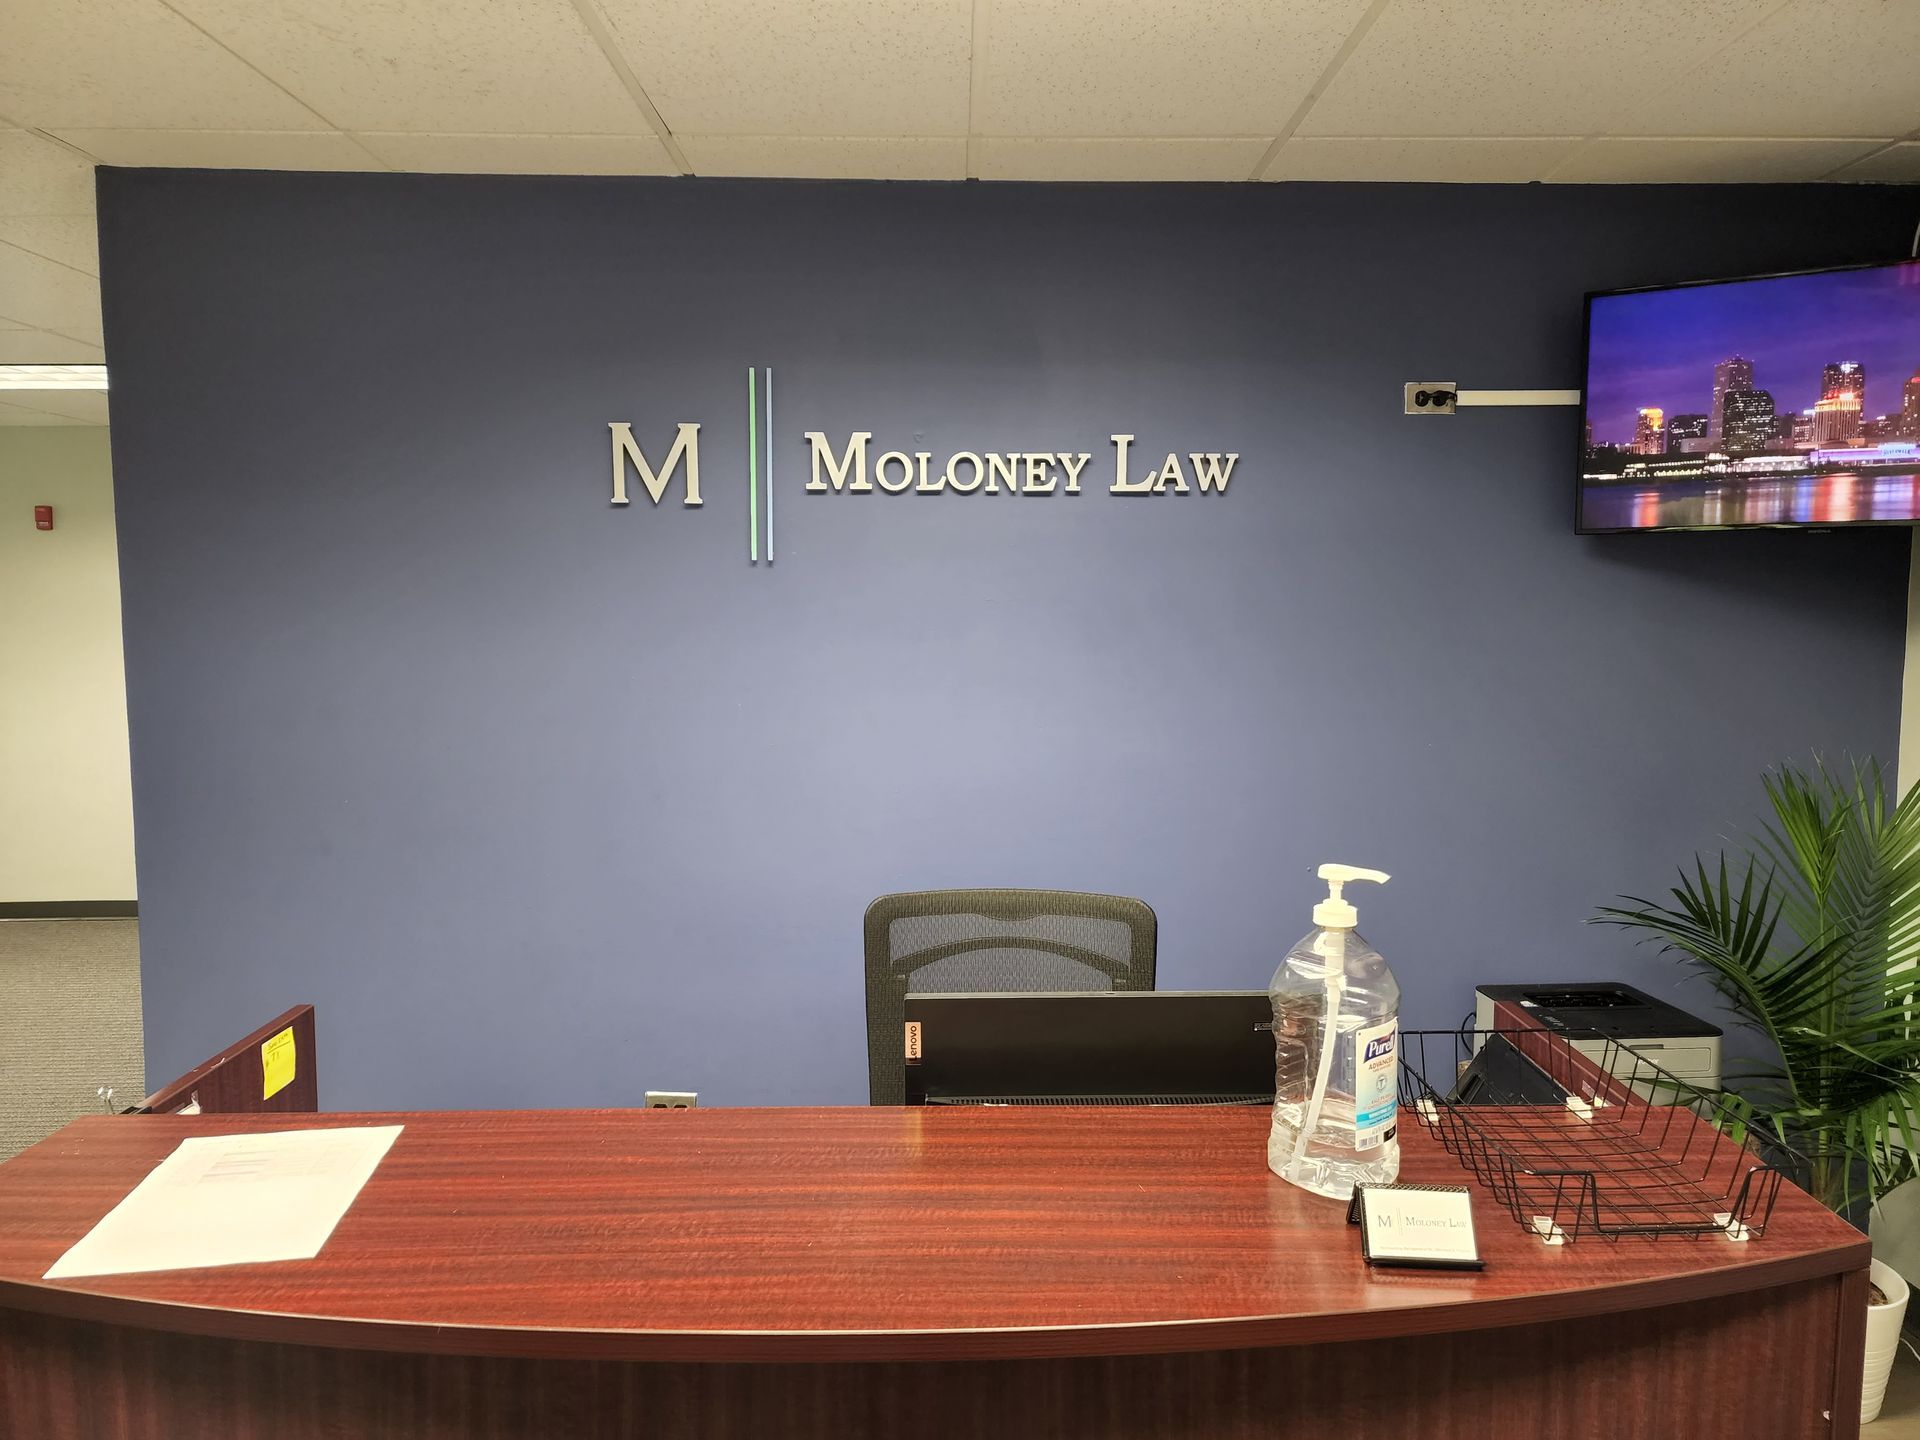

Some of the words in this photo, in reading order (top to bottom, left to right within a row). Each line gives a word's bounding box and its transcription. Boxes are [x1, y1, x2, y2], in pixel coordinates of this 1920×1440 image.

[607, 421, 704, 506] M
[804, 431, 1091, 495] MOLONEY
[1109, 434, 1239, 495] LAW
[1377, 1214, 1392, 1228] M
[1405, 1216, 1446, 1228] MOLONEY
